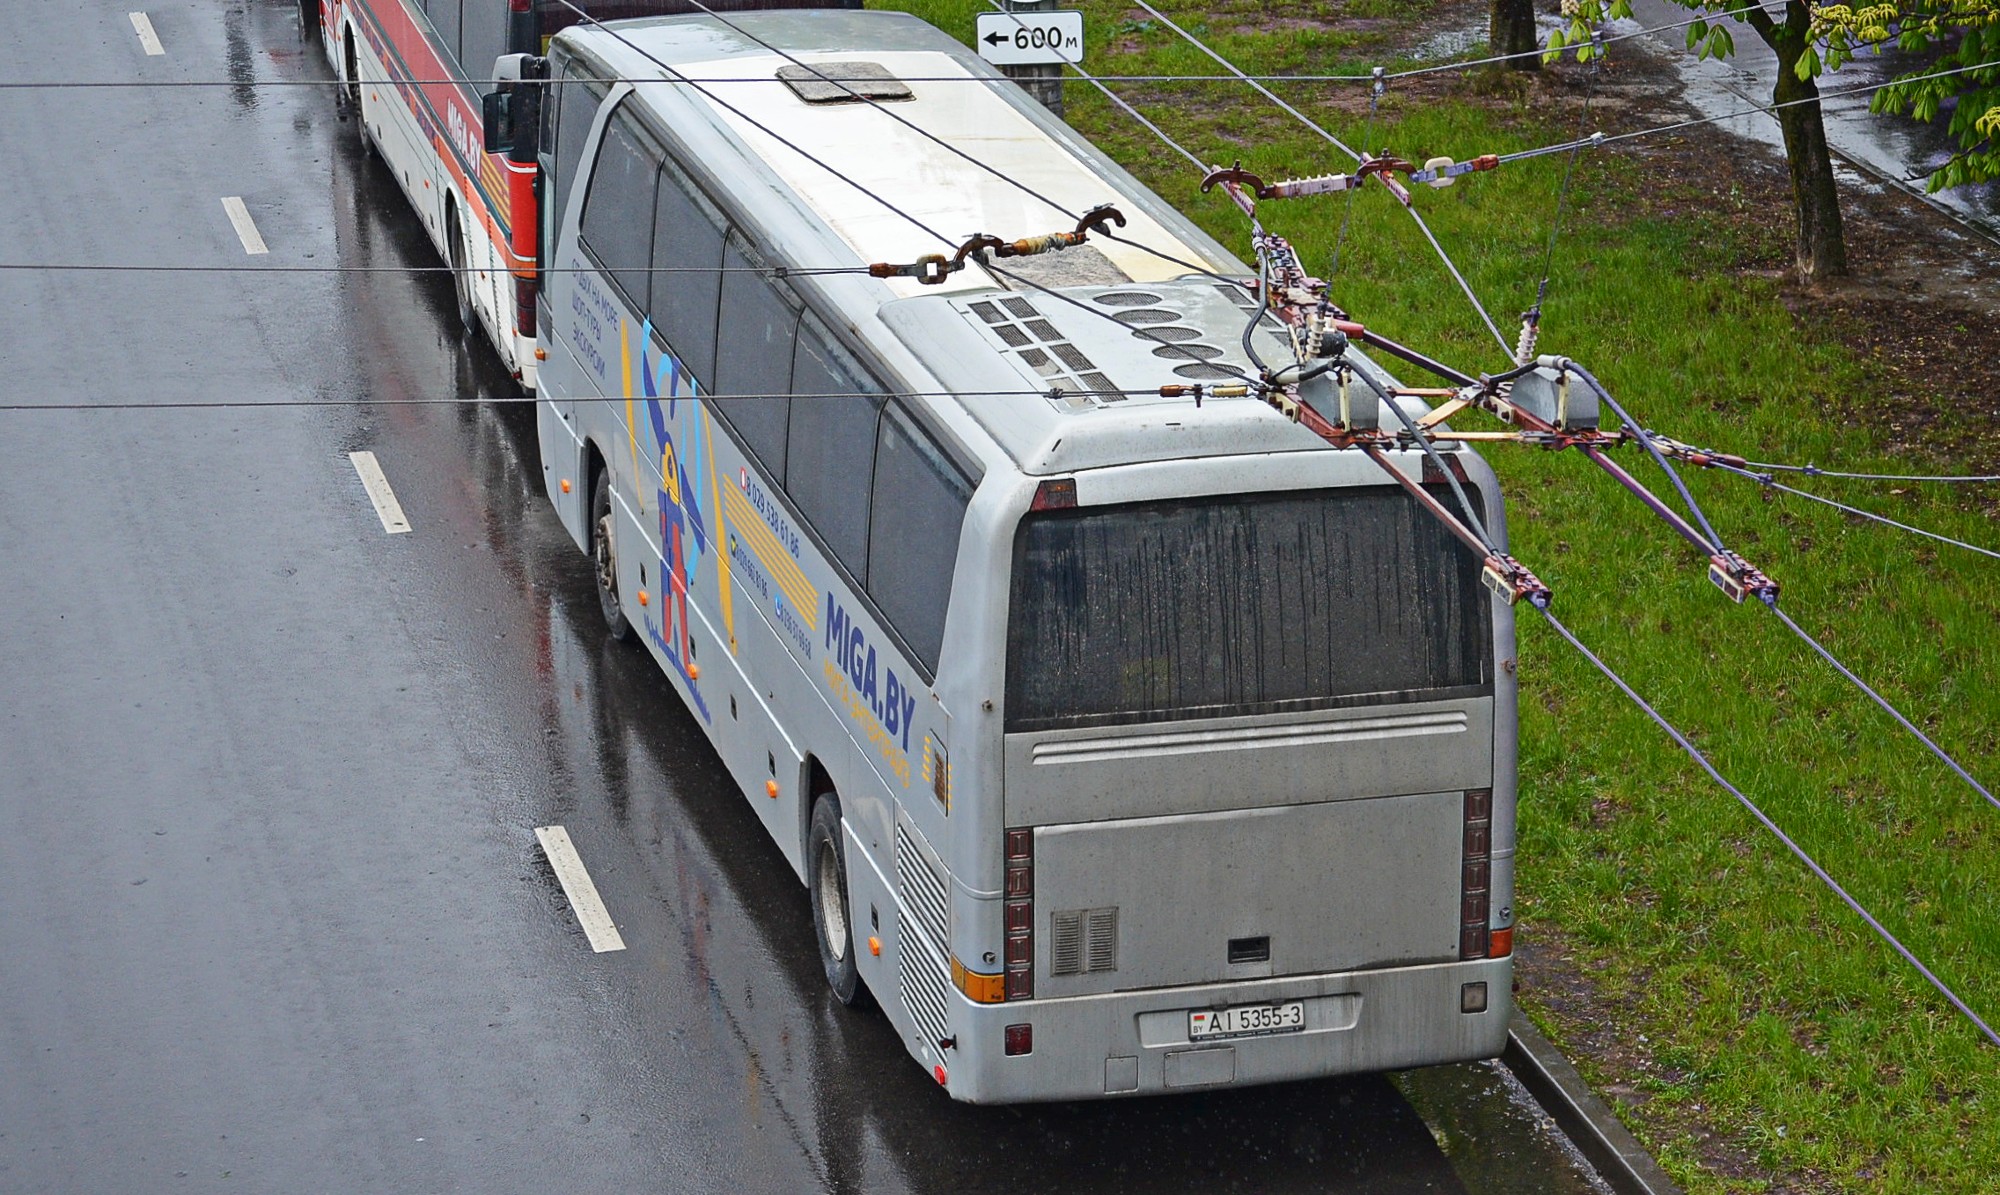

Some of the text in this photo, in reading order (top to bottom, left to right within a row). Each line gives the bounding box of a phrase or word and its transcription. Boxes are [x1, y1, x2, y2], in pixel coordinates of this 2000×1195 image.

[1014, 26, 1062, 49] 600
[447, 97, 481, 179] MIGA.BY
[572, 258, 618, 332] ОТДЫХ НА МОРЕ
[746, 476, 800, 559] 8 029 538 61 86
[825, 590, 915, 754] MIGA.BY
[1193, 1025, 1203, 1034] BY
[1240, 1005, 1301, 1029] 5355-3
